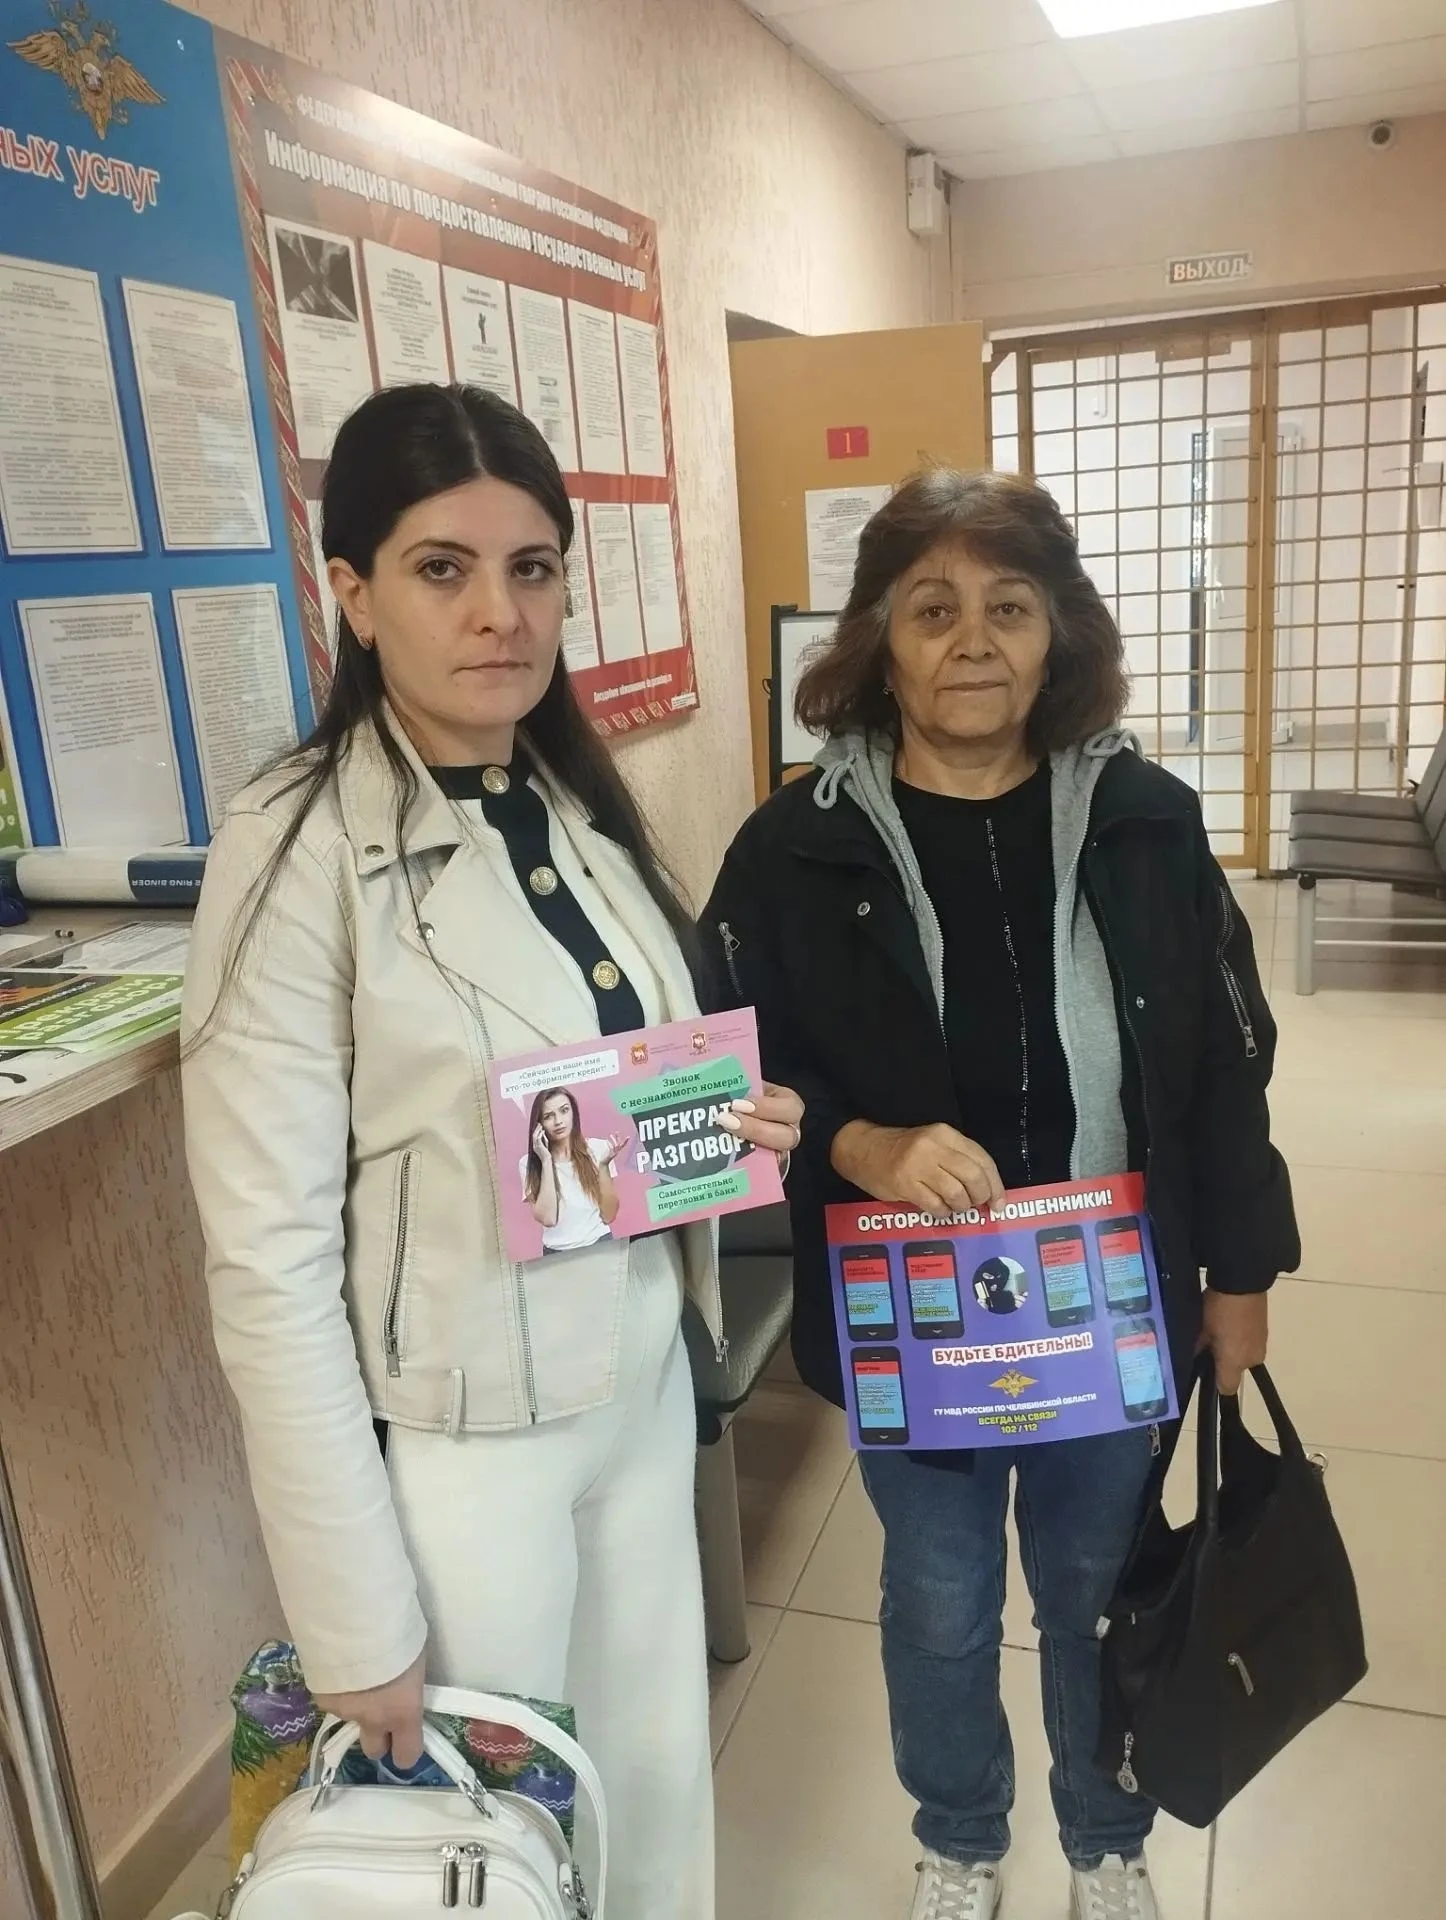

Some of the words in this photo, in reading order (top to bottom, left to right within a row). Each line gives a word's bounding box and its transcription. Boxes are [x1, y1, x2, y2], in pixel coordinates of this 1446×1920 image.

[66, 145, 160, 213] услуг
[264, 129, 389, 202] Информация
[389, 180, 412, 211] по
[412, 188, 532, 251] предоставлению
[532, 230, 624, 283] государственных
[623, 264, 646, 292] услуг
[1173, 257, 1246, 281] ВЫХОД
[843, 431, 853, 454] 1
[131, 879, 167, 887] BINDER
[169, 879, 193, 887] RING
[620, 1101, 627, 1109] с
[629, 1085, 698, 1107] незнакомого
[700, 1074, 744, 1091] номера?
[662, 1073, 701, 1087] Звонок
[638, 1101, 732, 1142] ПРЕКРАТ
[658, 1177, 733, 1199] Самостоятельно
[658, 1193, 705, 1210] перезвони
[715, 1185, 739, 1197] банк!
[934, 1348, 992, 1364] БУДЬТЕ
[995, 1333, 1092, 1362] БДИТЕЛЬНЫ!
[944, 1407, 962, 1416] МВД
[962, 1405, 994, 1415] РОССИИ
[994, 1404, 1006, 1413] ПО
[1006, 1397, 1062, 1412] ЧЕЛЯБИНСКОЙ
[1062, 1393, 1097, 1404] ОБЛАСТИ
[978, 1415, 1014, 1425] ВСЕГДА
[1014, 1413, 1027, 1423] НА
[1028, 1410, 1057, 1421] СВЯЗИ
[1001, 1424, 1017, 1434] 102
[1024, 1423, 1038, 1433] 112
